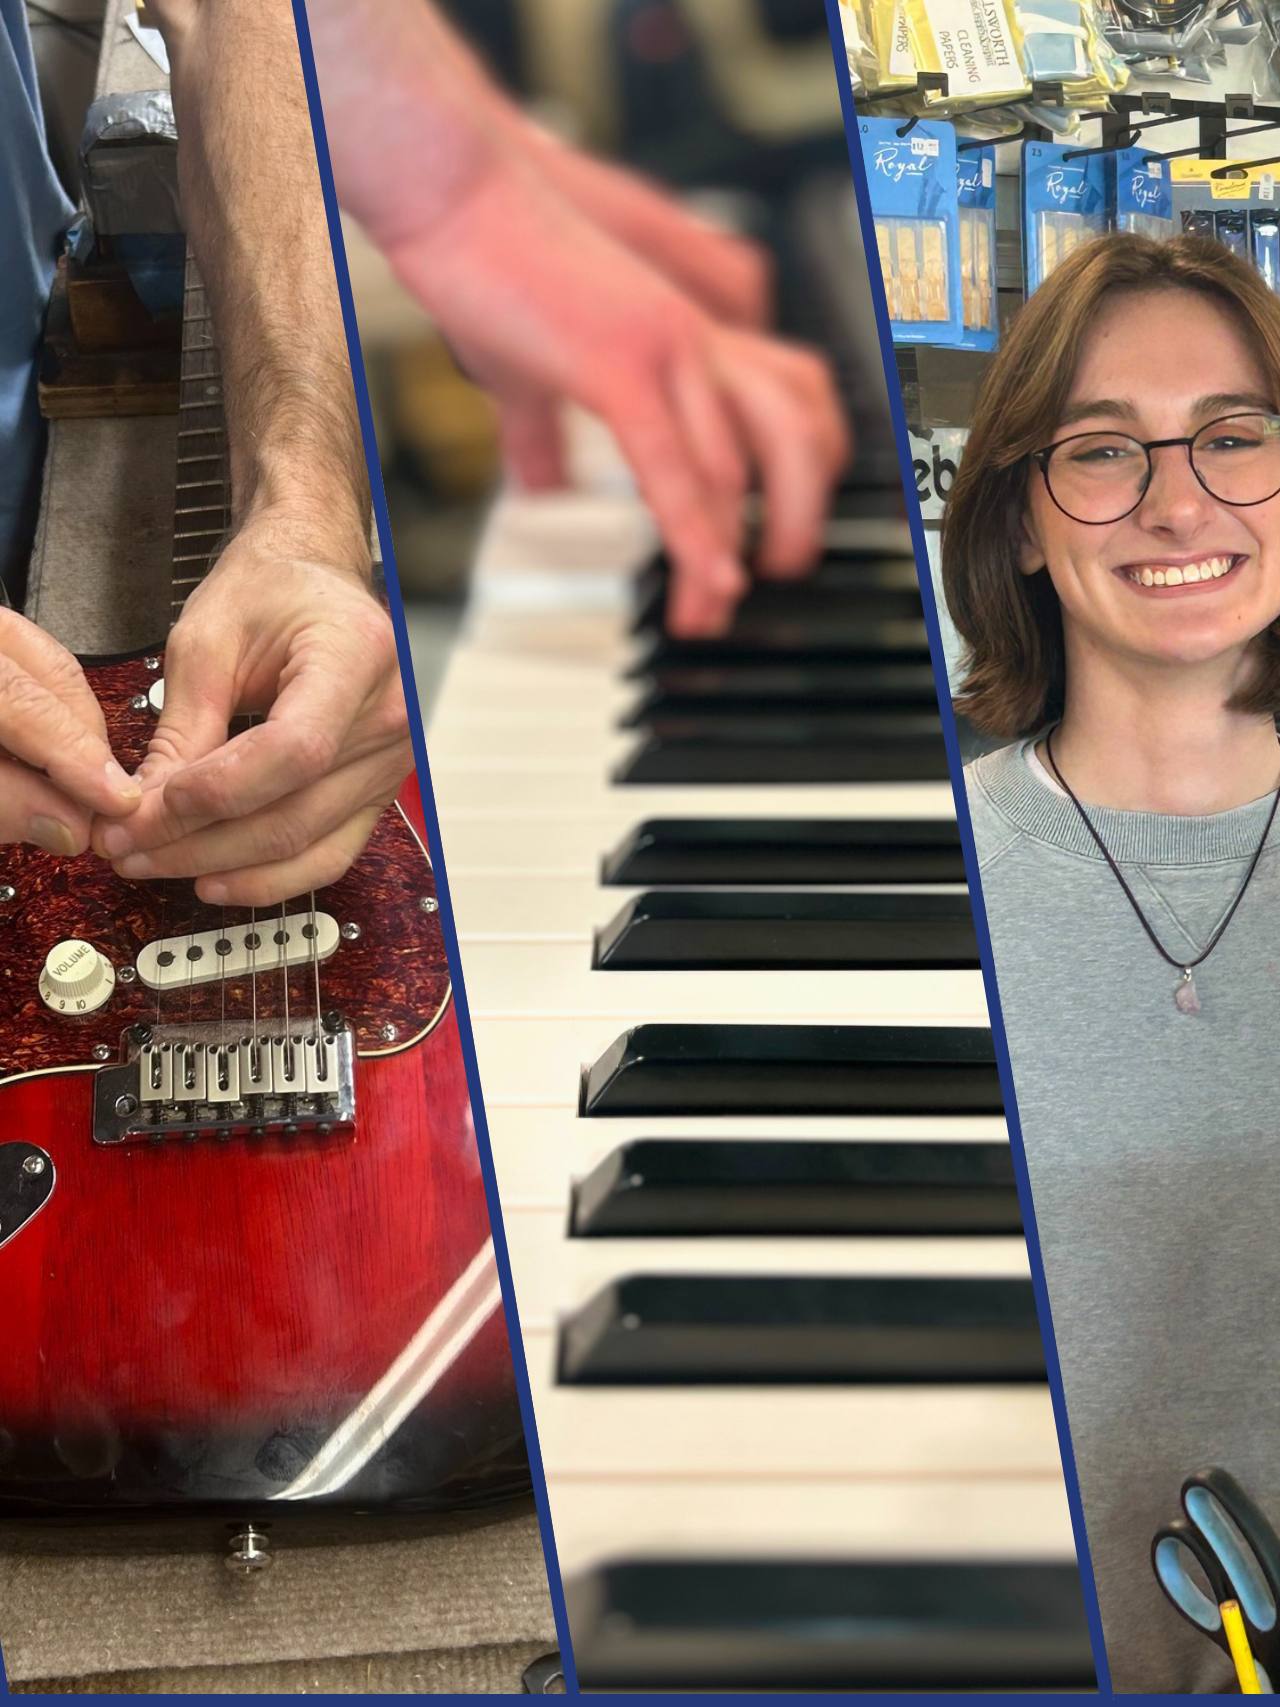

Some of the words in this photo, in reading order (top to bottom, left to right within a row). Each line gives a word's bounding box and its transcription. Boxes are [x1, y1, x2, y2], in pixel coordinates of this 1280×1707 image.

[939, 30, 958, 69] PAPERS
[982, 0, 1010, 67] LSWORTH
[957, 29, 981, 83] CLEANING
[873, 147, 933, 183] Royal
[1046, 171, 1088, 204] Royal
[52, 945, 91, 976] VOLUME
[76, 1000, 87, 1010] 10
